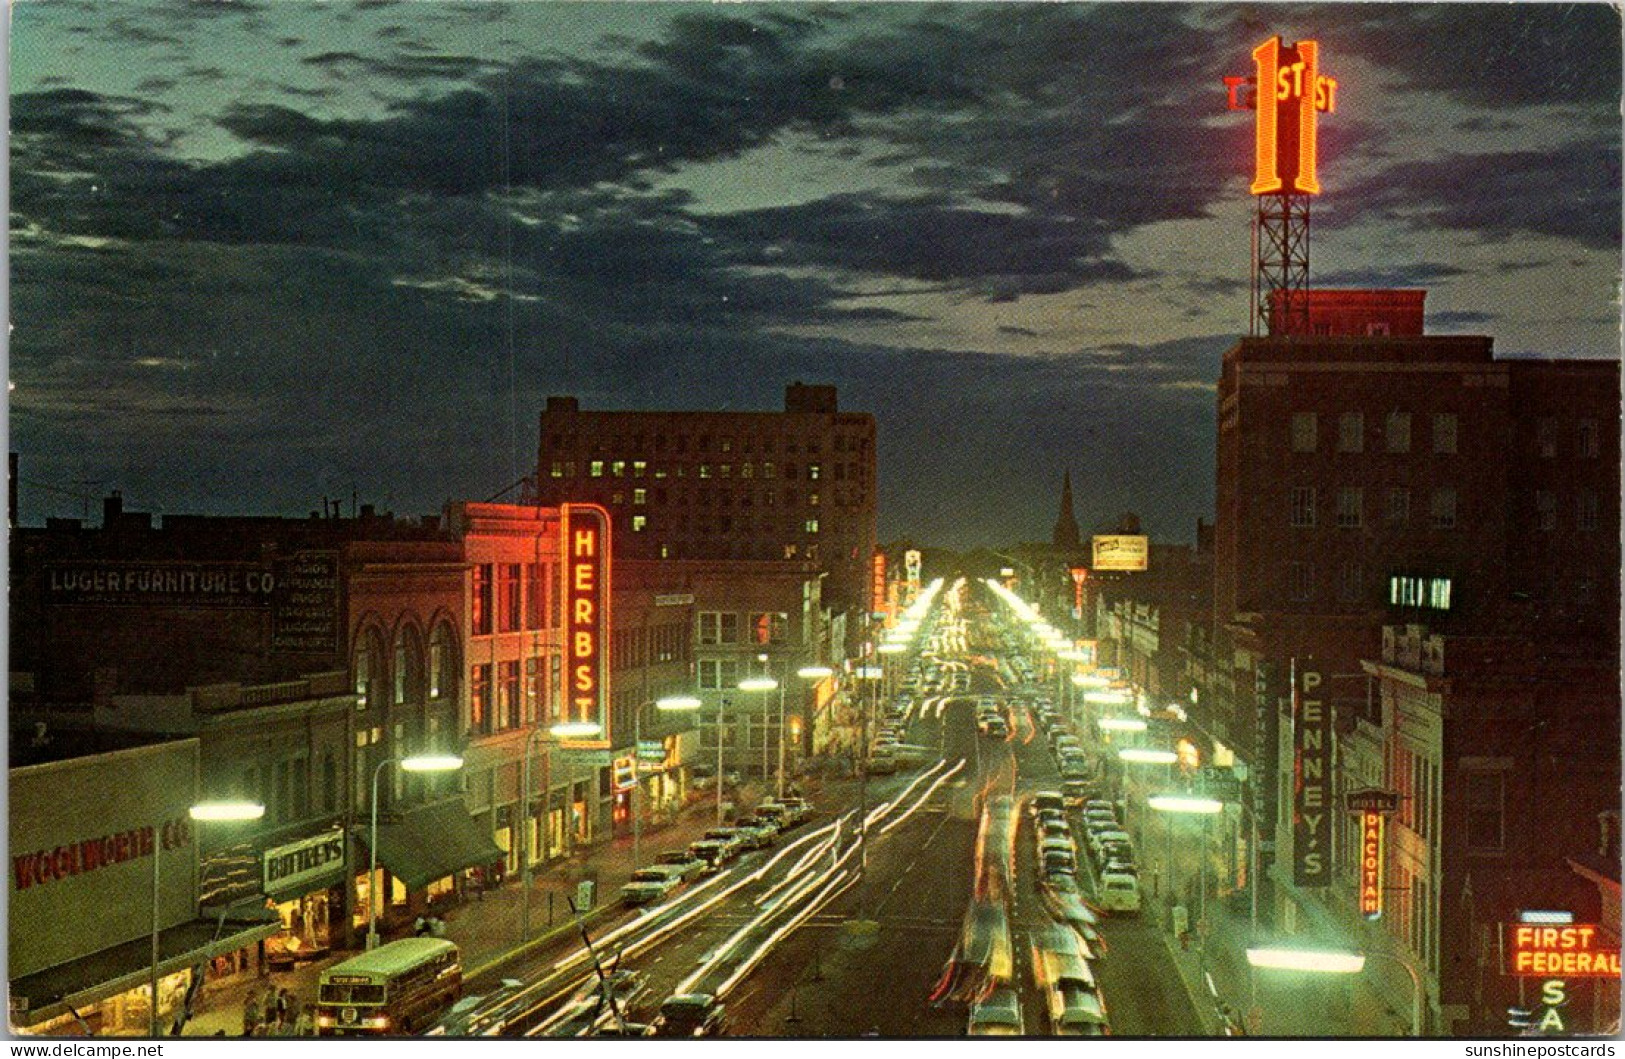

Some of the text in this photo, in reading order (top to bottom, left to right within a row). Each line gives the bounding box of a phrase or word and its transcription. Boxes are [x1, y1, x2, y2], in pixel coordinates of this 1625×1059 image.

[50, 571, 120, 592] LUGER
[124, 571, 240, 593] FURNITURE
[573, 529, 595, 724] HERBST
[1301, 671, 1324, 876] PENNEY'S
[13, 825, 154, 891] WOOLWORTH
[1364, 813, 1379, 911] DACOTAH
[1516, 927, 1595, 949] FIRST
[1516, 951, 1622, 973] FEDERAL
